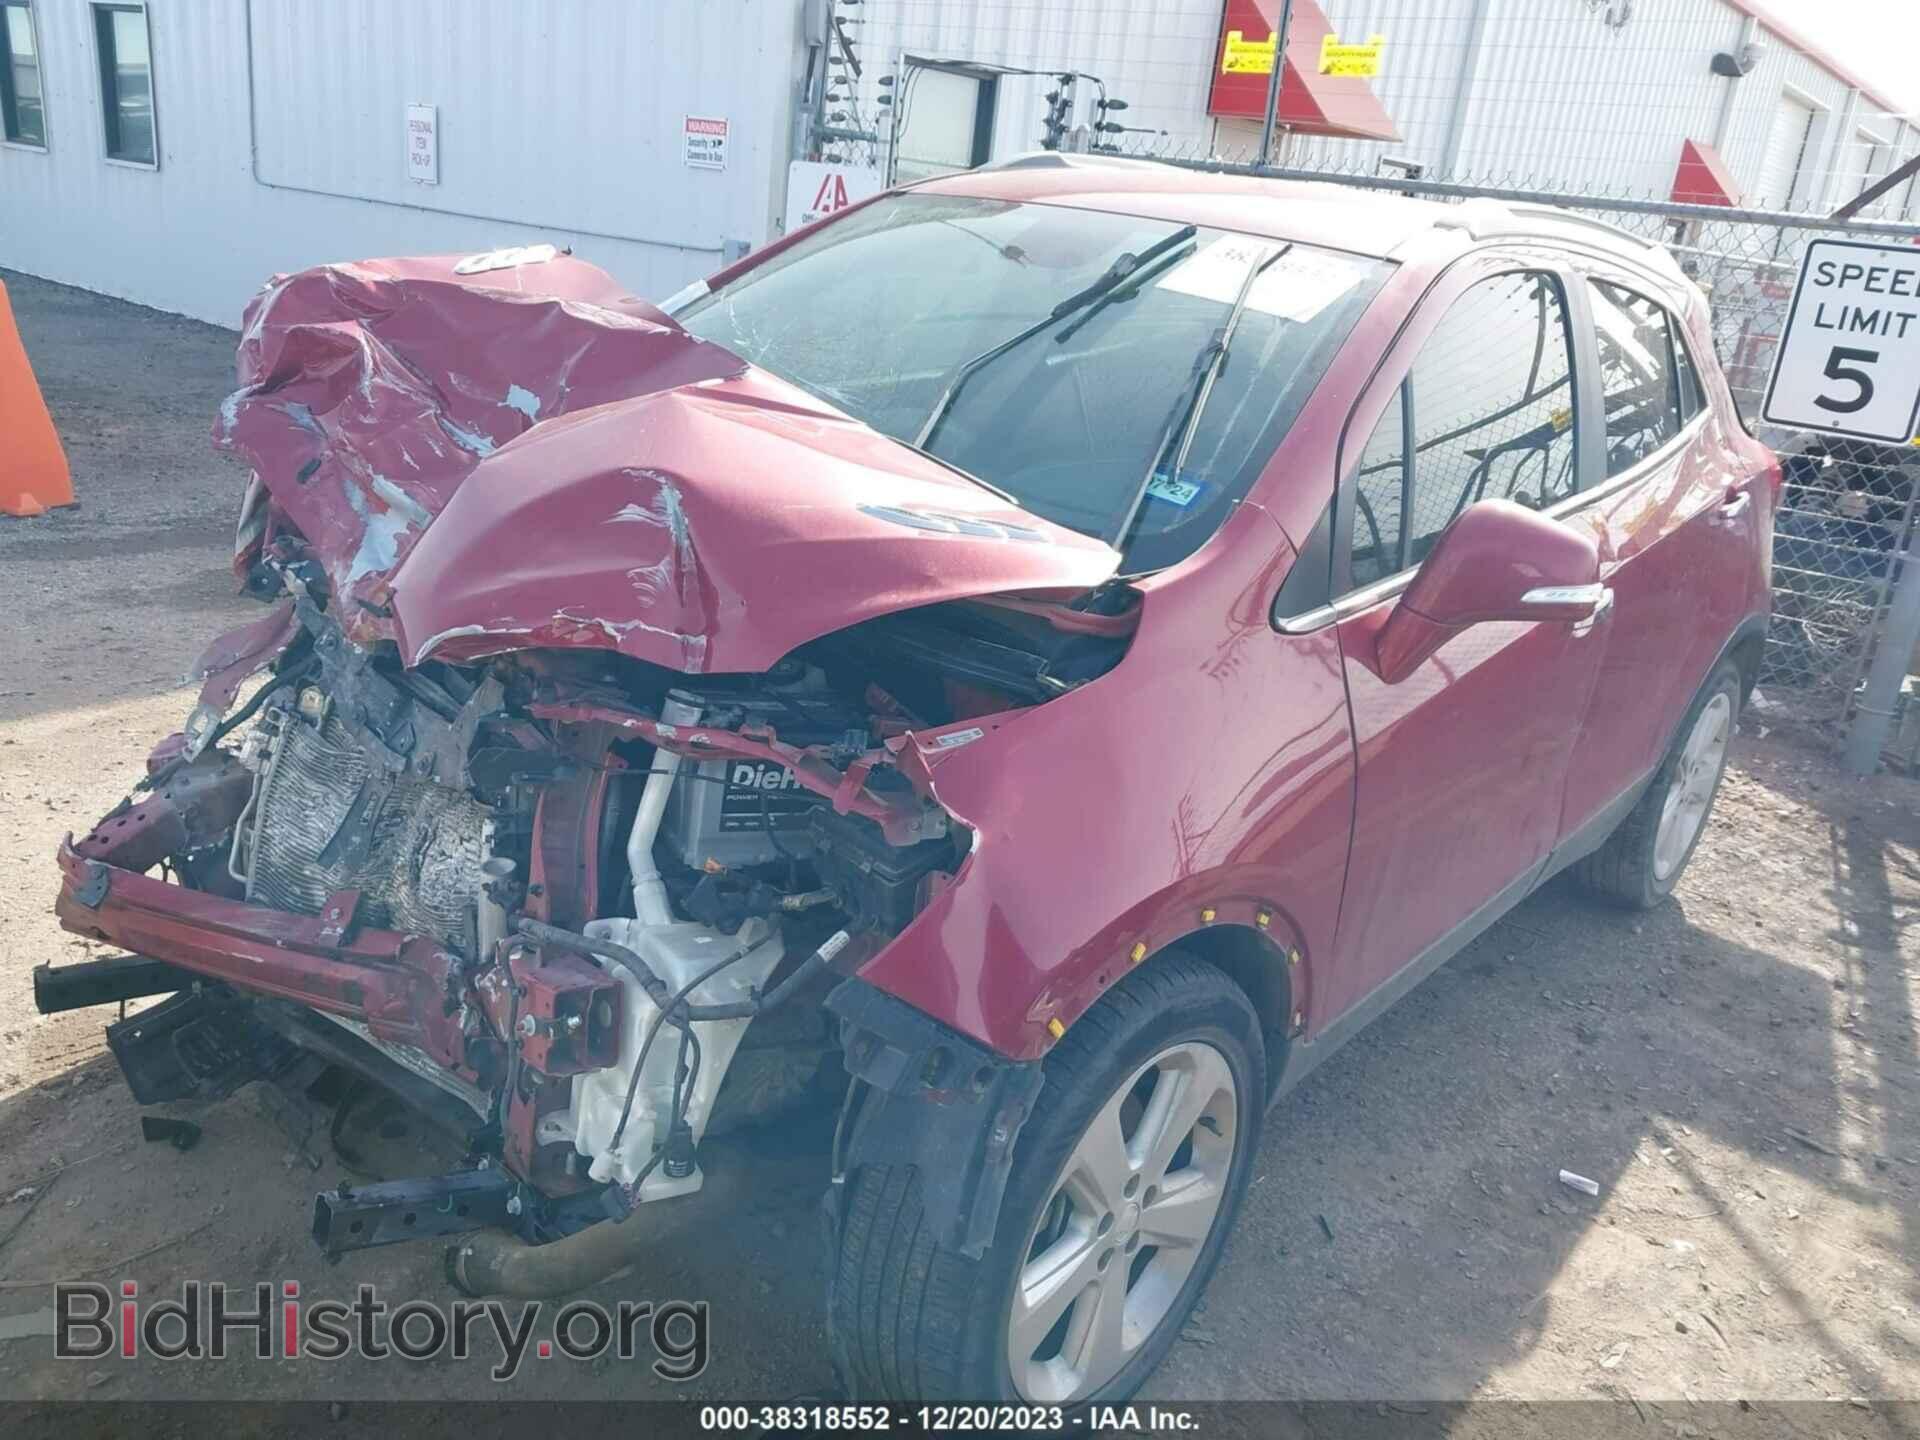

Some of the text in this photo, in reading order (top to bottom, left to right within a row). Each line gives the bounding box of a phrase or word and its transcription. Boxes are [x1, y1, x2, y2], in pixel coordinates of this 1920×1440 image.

[687, 120, 725, 134] WARNING
[1813, 261, 1920, 298] SPEE
[1813, 302, 1917, 339] LIMIT
[1813, 345, 1880, 414] 5
